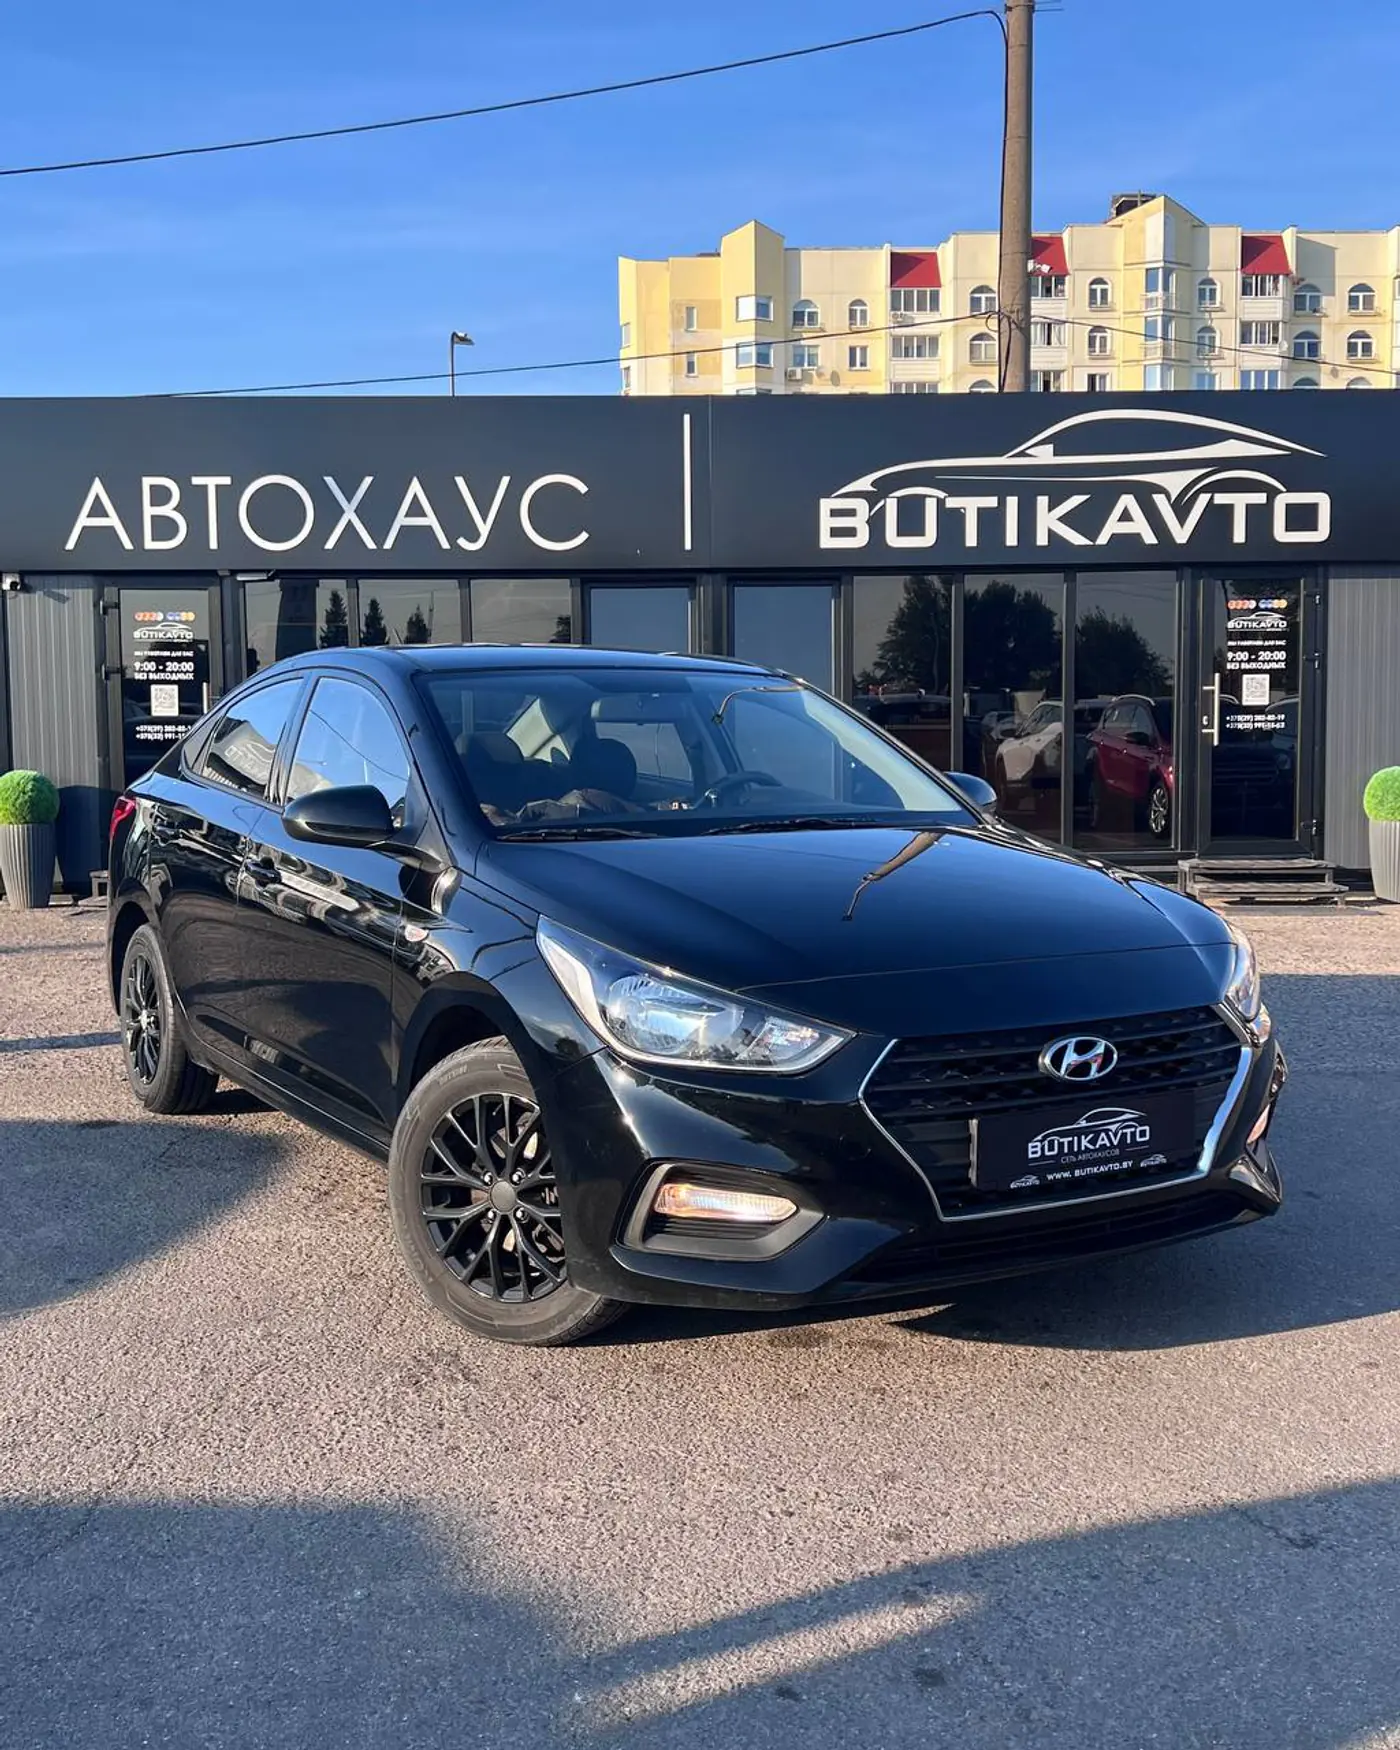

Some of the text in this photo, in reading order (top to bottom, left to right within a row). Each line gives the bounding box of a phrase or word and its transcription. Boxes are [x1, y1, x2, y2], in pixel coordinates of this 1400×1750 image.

[65, 474, 590, 552] АВТОХАУС
[818, 491, 1332, 549] BUTIKAVTO
[1227, 620, 1287, 628] BUTIKAVTO
[134, 661, 156, 671] 9:00
[165, 661, 194, 672] 20:00
[1227, 651, 1249, 661] 9:00
[1258, 651, 1287, 661] 20:00
[1028, 1125, 1150, 1159] BUTIKAVTO
